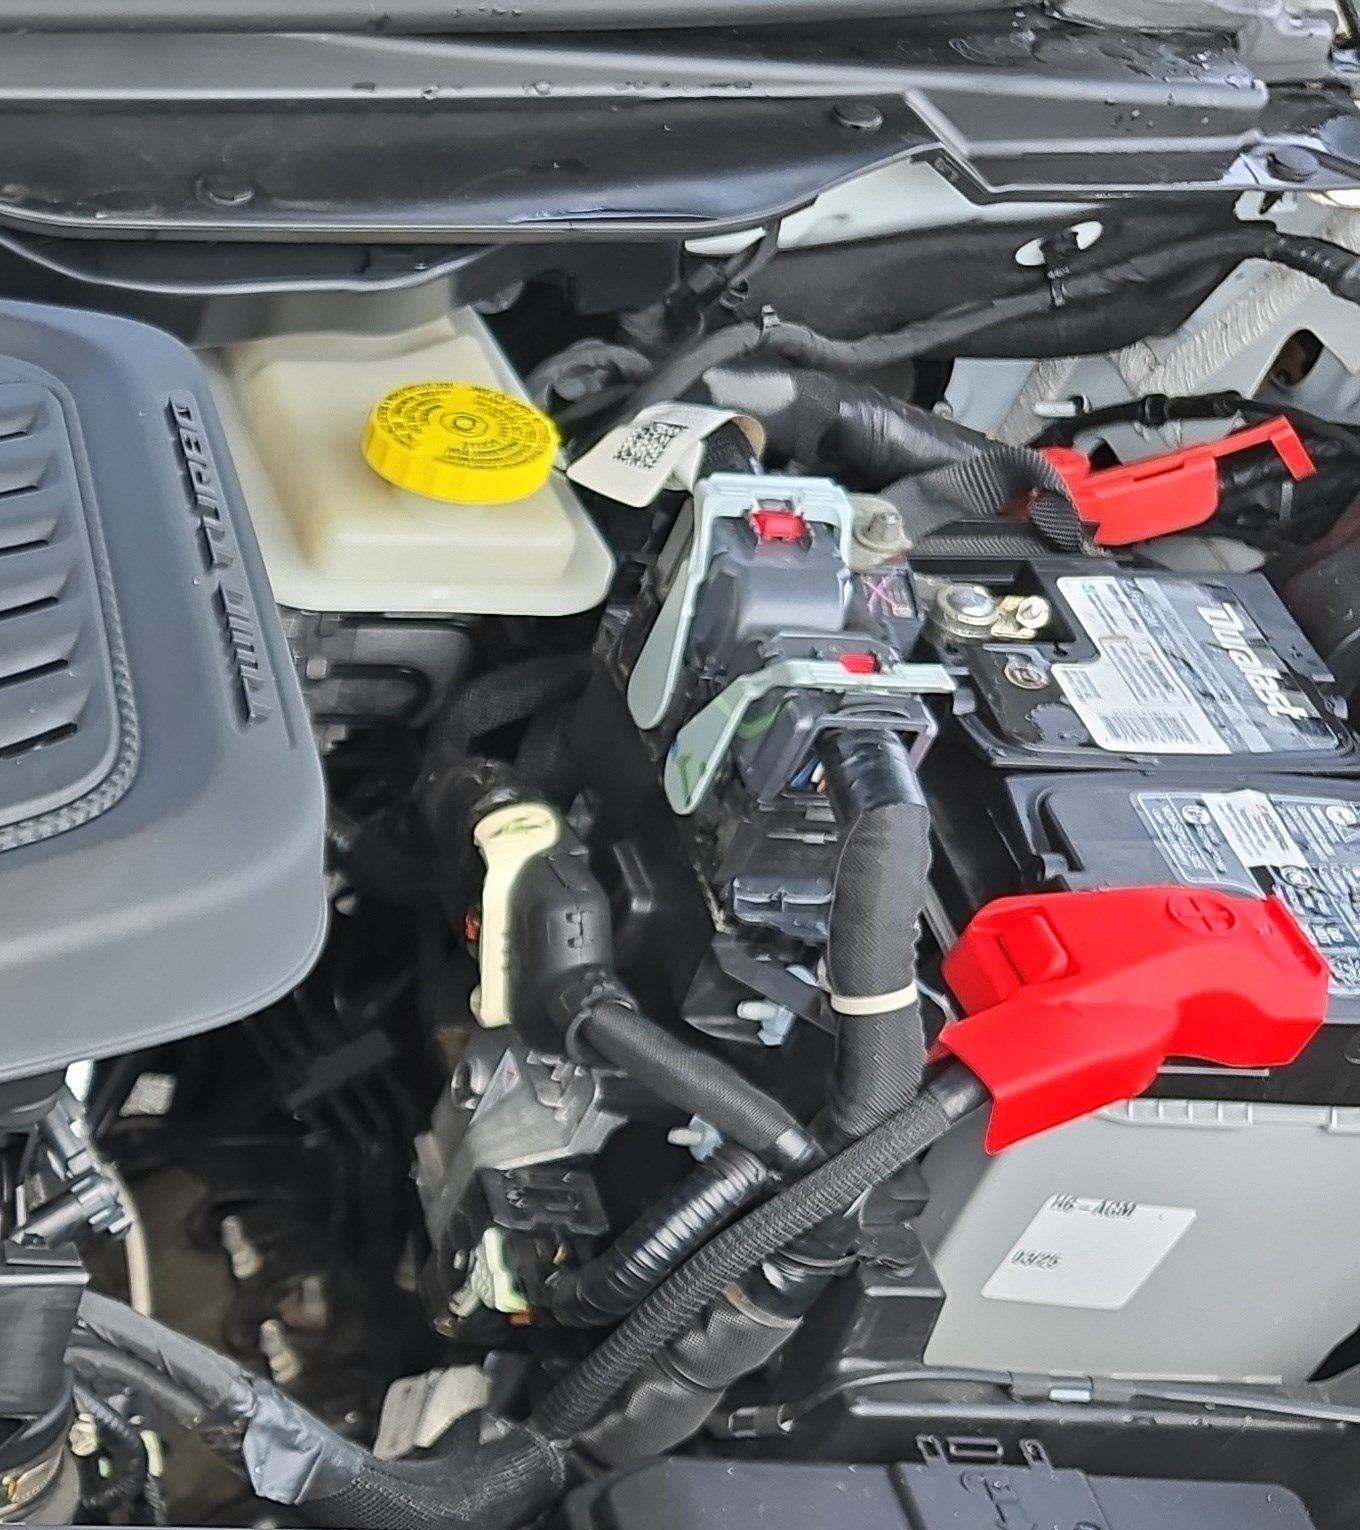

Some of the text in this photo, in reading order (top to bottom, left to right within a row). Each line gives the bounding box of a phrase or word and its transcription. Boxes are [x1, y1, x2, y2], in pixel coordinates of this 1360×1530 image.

[168, 396, 273, 724] TWIN TURBO
[1197, 602, 1309, 721] Duralast
[1092, 1199, 1137, 1218] AGM
[1012, 1250, 1062, 1270] 03/25
